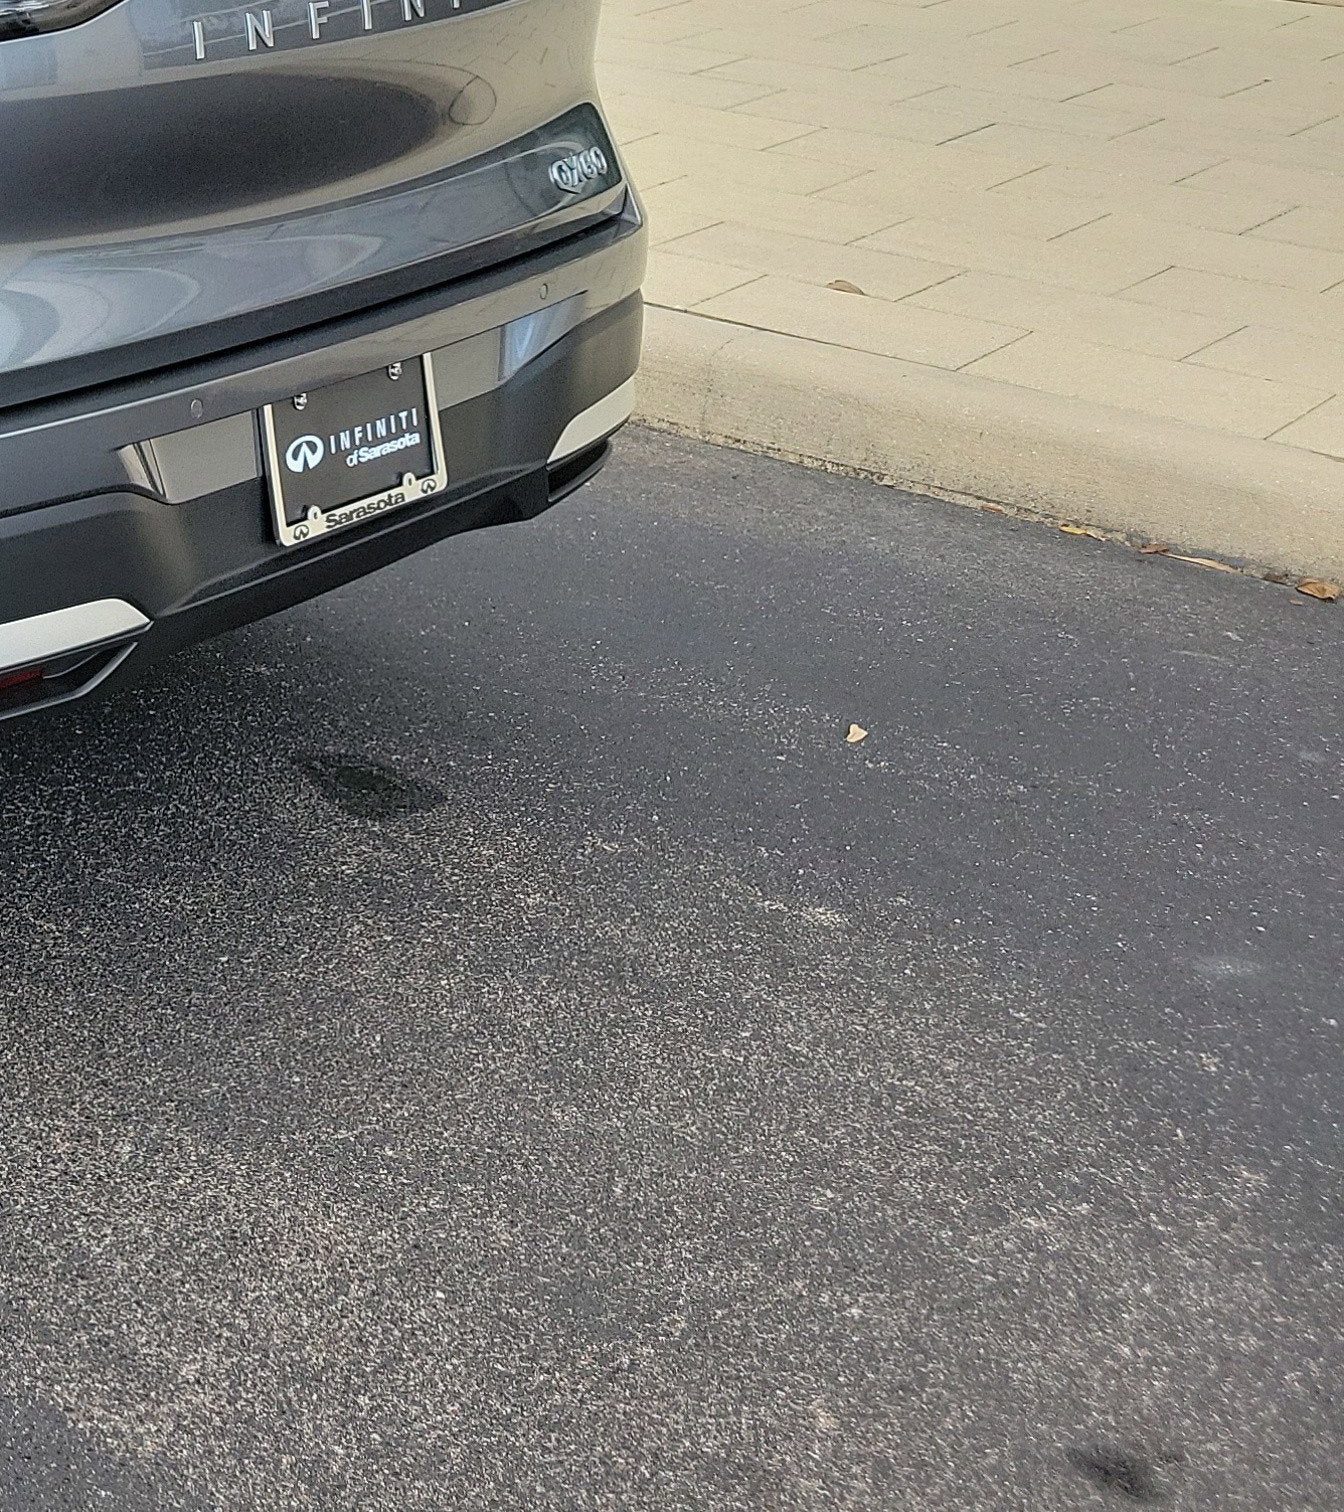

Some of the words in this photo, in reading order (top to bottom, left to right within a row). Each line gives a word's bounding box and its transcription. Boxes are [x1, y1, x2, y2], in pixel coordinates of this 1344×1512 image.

[549, 146, 608, 193] QX60
[329, 408, 418, 454] INFINITI
[346, 449, 358, 467] of
[358, 432, 420, 463] Sarasota
[325, 491, 406, 529] Sarasota
